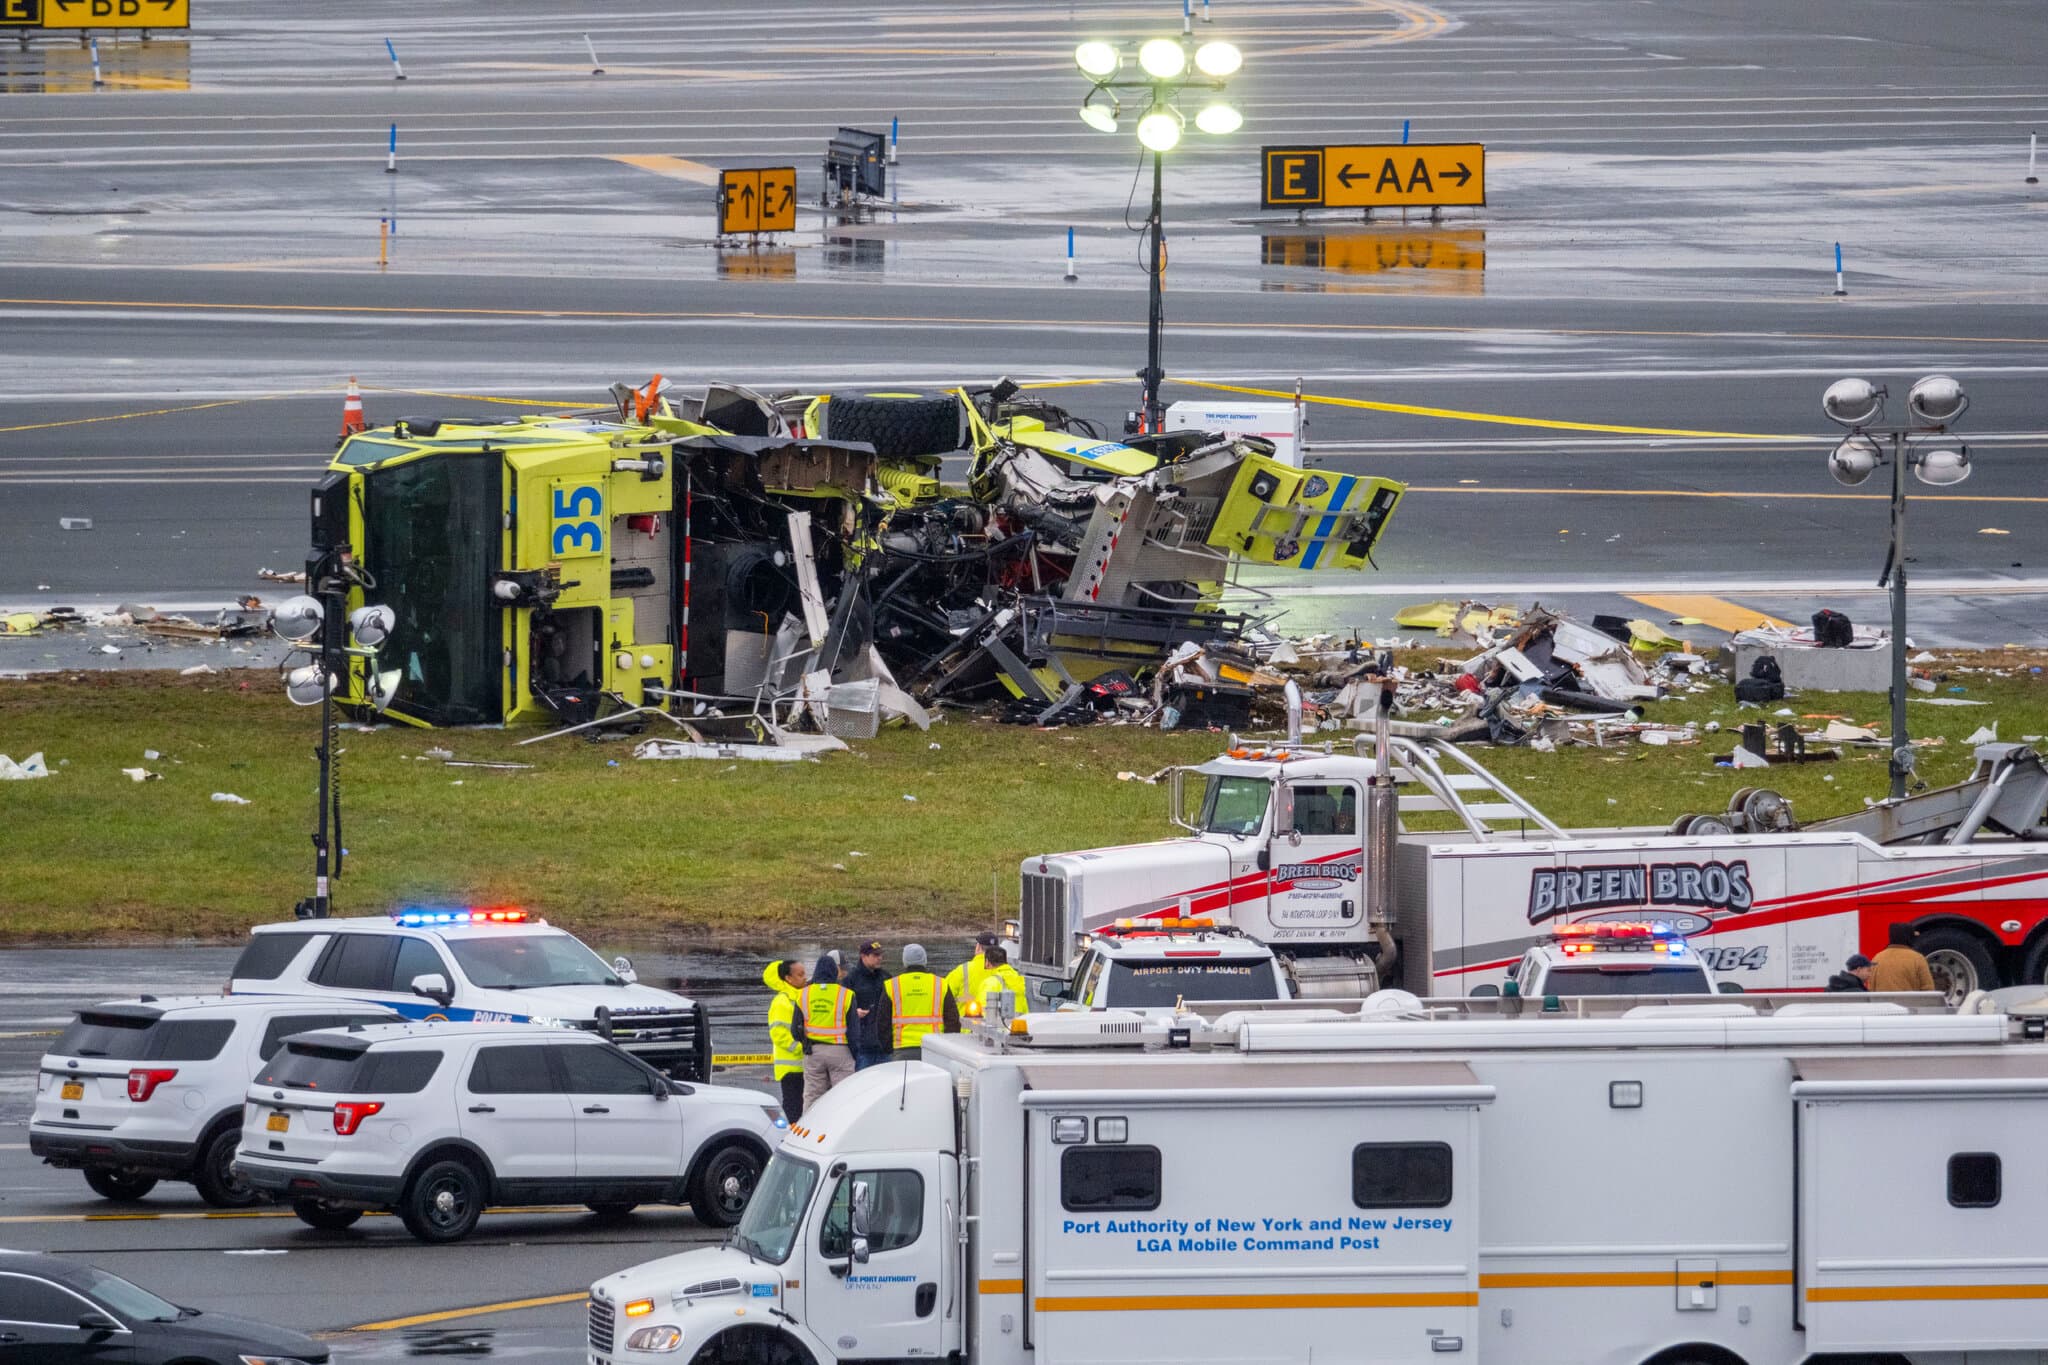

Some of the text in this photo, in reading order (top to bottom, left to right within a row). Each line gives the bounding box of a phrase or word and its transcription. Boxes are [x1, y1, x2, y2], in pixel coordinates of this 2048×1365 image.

[1283, 158, 1434, 195] E AA
[725, 182, 776, 220] F E
[552, 486, 603, 555] 35
[1277, 864, 1357, 883] BREEN BROS
[1528, 860, 1754, 925] BREEN BROS
[1133, 965, 1251, 977] AIRPORT DUTY MANAGER
[473, 1010, 513, 1024] POLICE
[1063, 1216, 1453, 1236] Port Authority of New York and New Jersey
[1137, 1236, 1380, 1252] LGA Mobile Command Post
[879, 1275, 916, 1283] AUTHORITY
